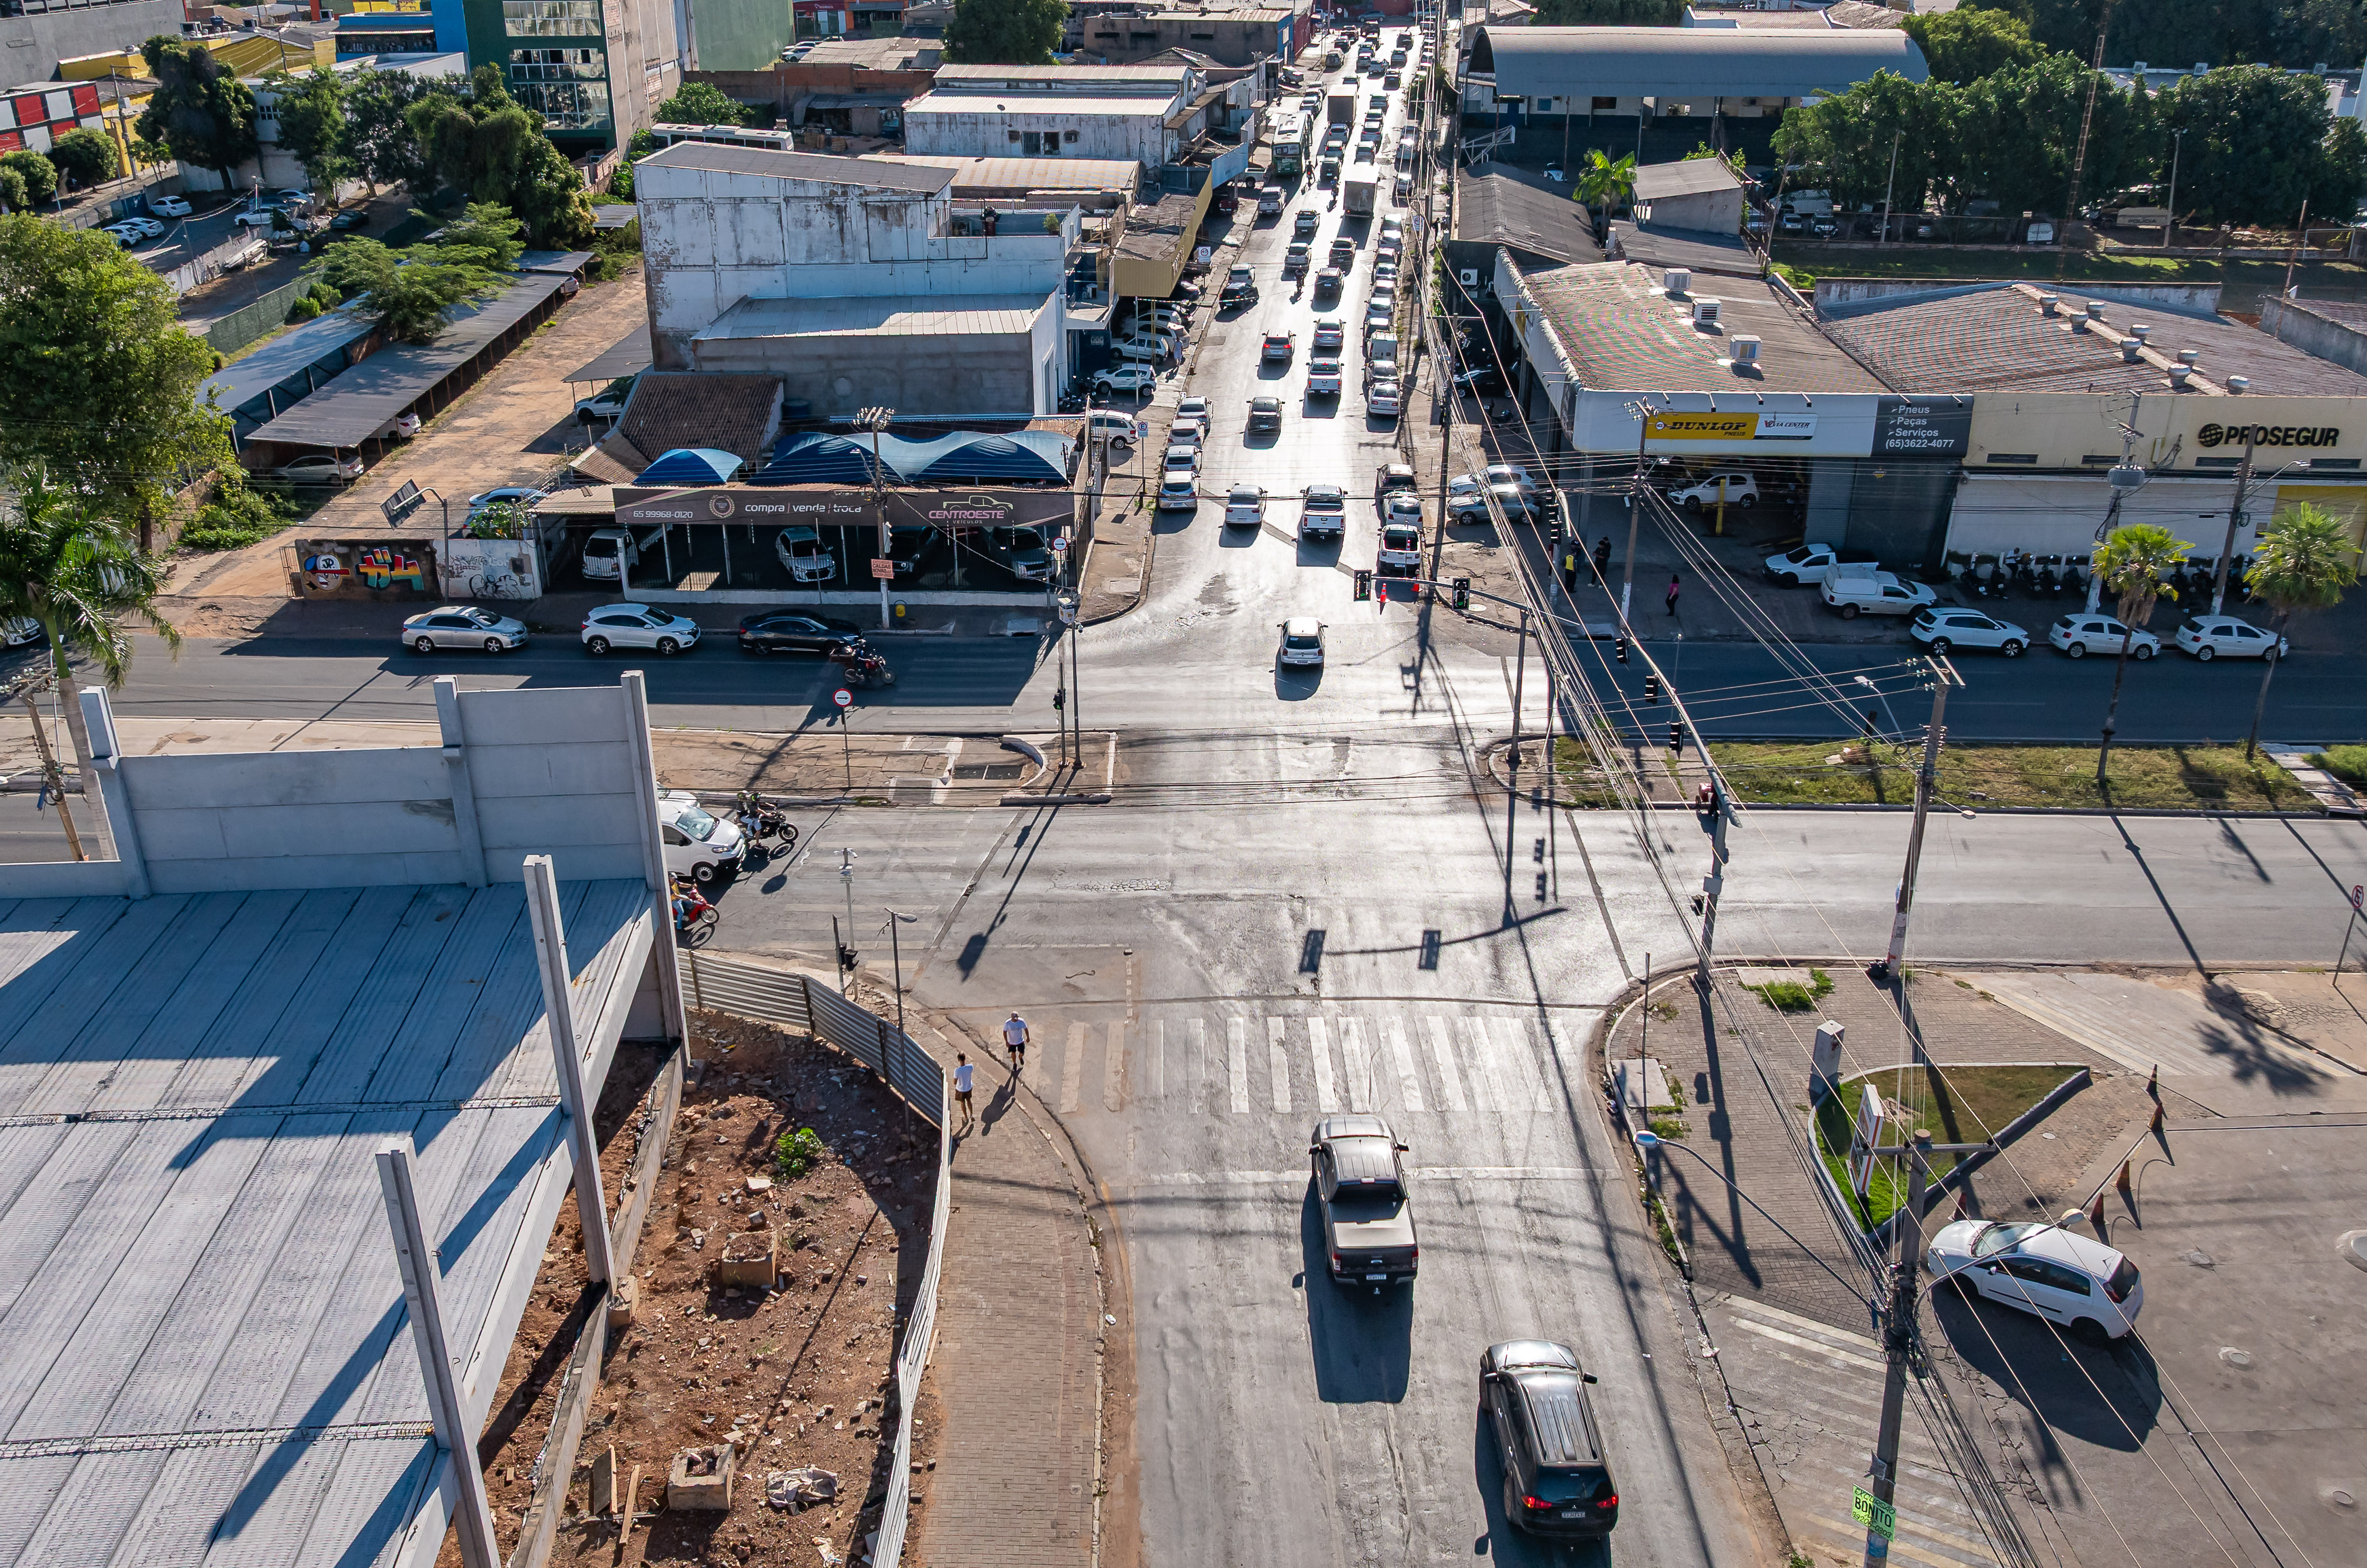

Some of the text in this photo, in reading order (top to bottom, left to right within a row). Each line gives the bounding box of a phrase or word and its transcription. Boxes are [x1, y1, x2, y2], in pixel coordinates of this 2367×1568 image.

[1898, 405, 1930, 414] Pneus
[1669, 421, 1747, 430] DUNLOP
[1897, 417, 1927, 427] Peças
[1895, 428, 1939, 438] Serviços
[2224, 426, 2340, 447] PROSEGUR
[1885, 439, 1955, 449] (65)3622-4077
[745, 504, 785, 514] compra
[793, 504, 825, 512] venda
[929, 510, 1005, 519] CENTROESTE
[1855, 1496, 1892, 1528] BONITO
